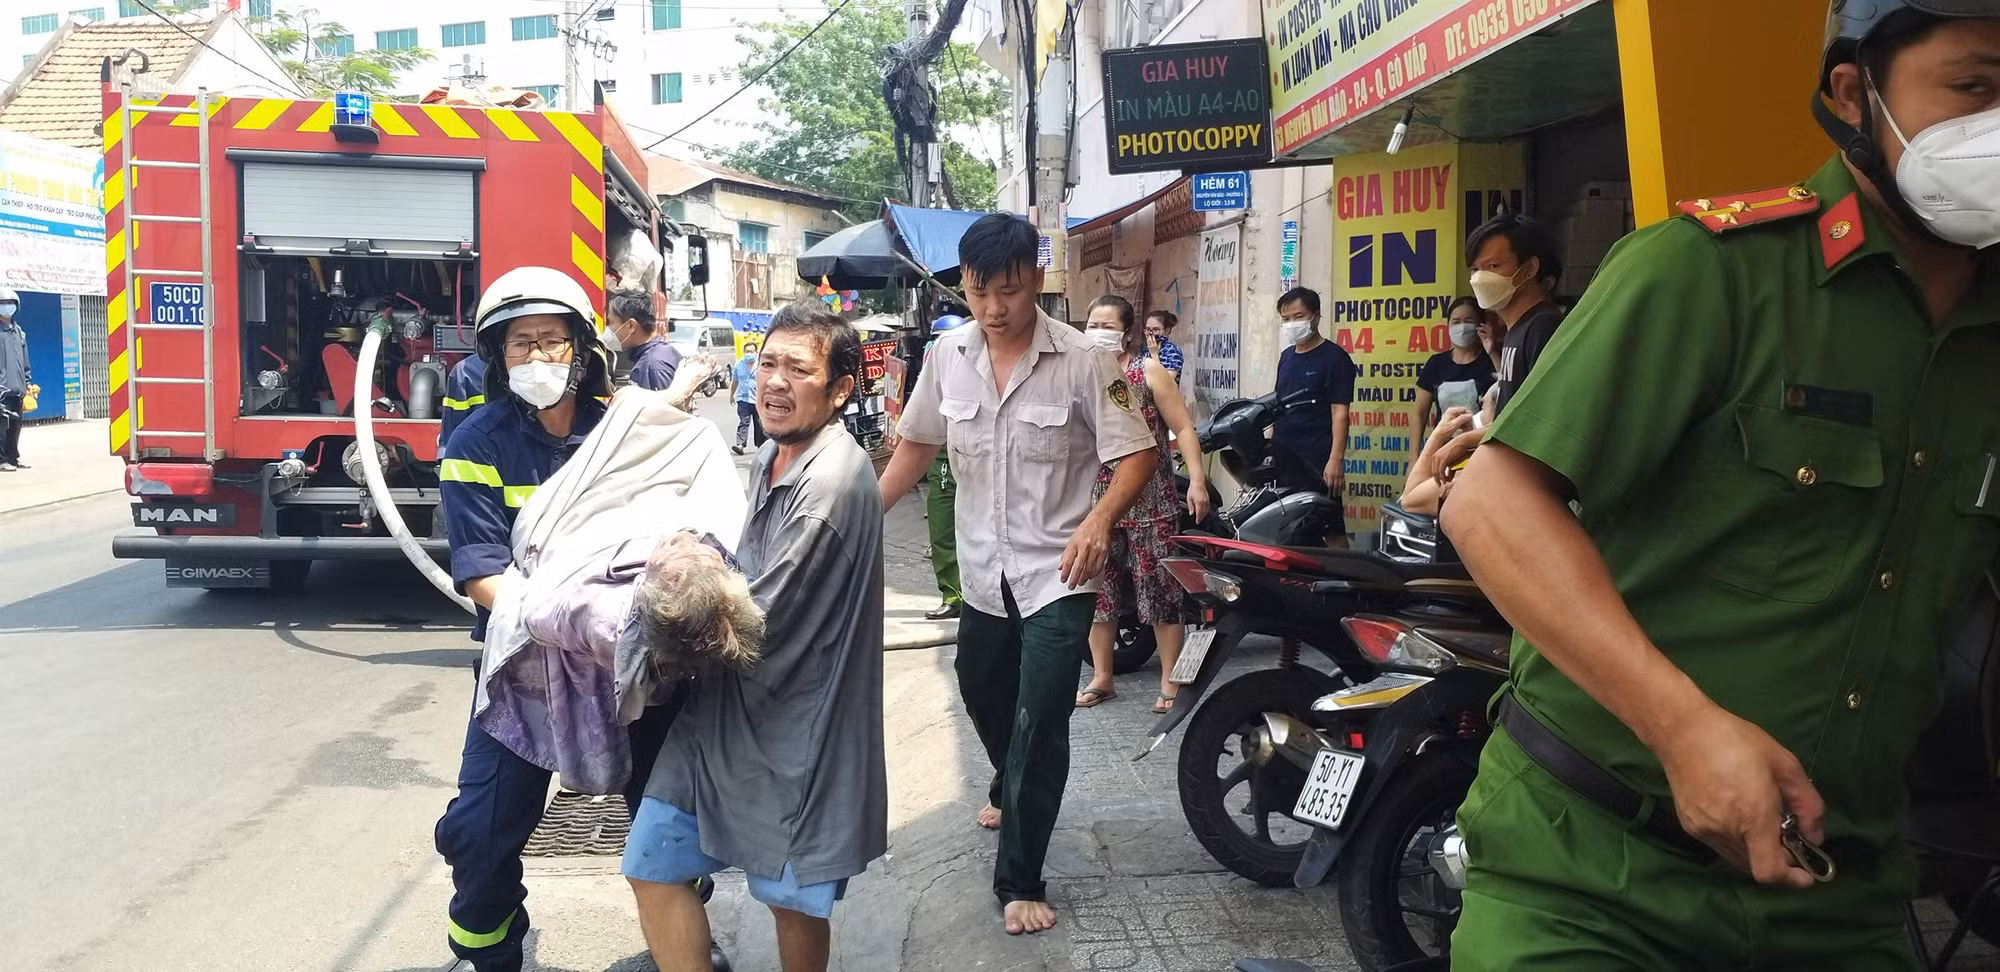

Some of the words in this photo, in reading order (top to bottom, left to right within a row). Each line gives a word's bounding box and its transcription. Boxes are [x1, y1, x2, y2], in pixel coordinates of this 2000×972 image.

[1281, 59, 1291, 93] IN
[1291, 42, 1313, 87] LUẬN
[1312, 27, 1333, 71] VĂN
[1338, 11, 1357, 54] MẠ
[1142, 59, 1179, 83] GIA
[1185, 55, 1229, 80] HUY
[1311, 99, 1329, 132] VĂN
[1387, 53, 1404, 92] GÒ
[1403, 36, 1428, 82] VẤP
[1117, 98, 1139, 122] IN
[1147, 91, 1191, 121] MÀU
[1118, 124, 1262, 158] PHOTOCOPPY
[1227, 178, 1240, 189] 61
[1337, 173, 1384, 221] GIA
[1393, 164, 1451, 215] HUY
[1349, 229, 1437, 289] IN
[163, 286, 201, 305] 50CD
[1334, 295, 1452, 323] PHOTOCOPY
[1336, 327, 1375, 354] A4
[1357, 386, 1393, 402] MÀU
[1343, 459, 1367, 475] CAN
[1349, 482, 1392, 498] PLASTIC
[140, 508, 218, 522] MAN
[181, 567, 253, 579] GIMAEX
